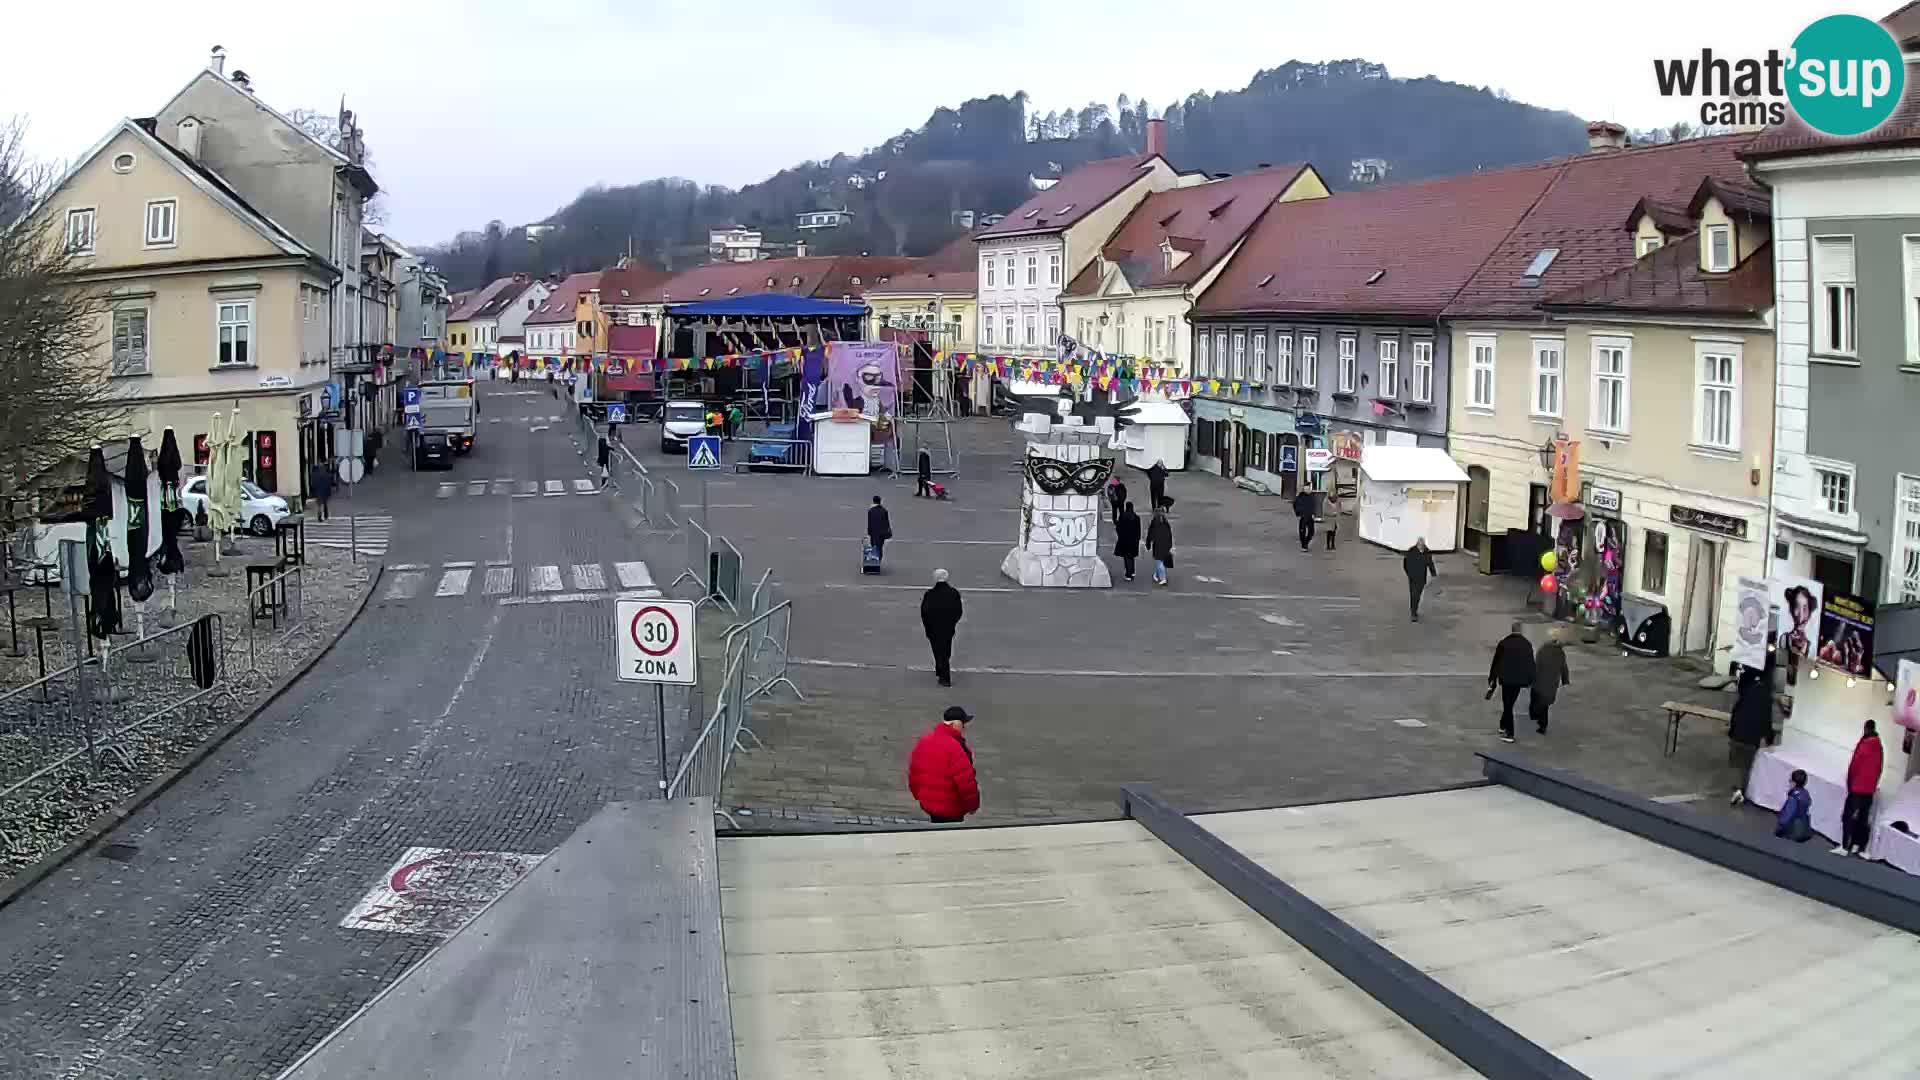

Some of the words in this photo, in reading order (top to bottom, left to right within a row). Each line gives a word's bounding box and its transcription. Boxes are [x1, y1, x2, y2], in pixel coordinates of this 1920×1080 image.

[1047, 515, 1087, 546] 200
[643, 622, 668, 643] 30
[634, 659, 678, 676] ZONA
